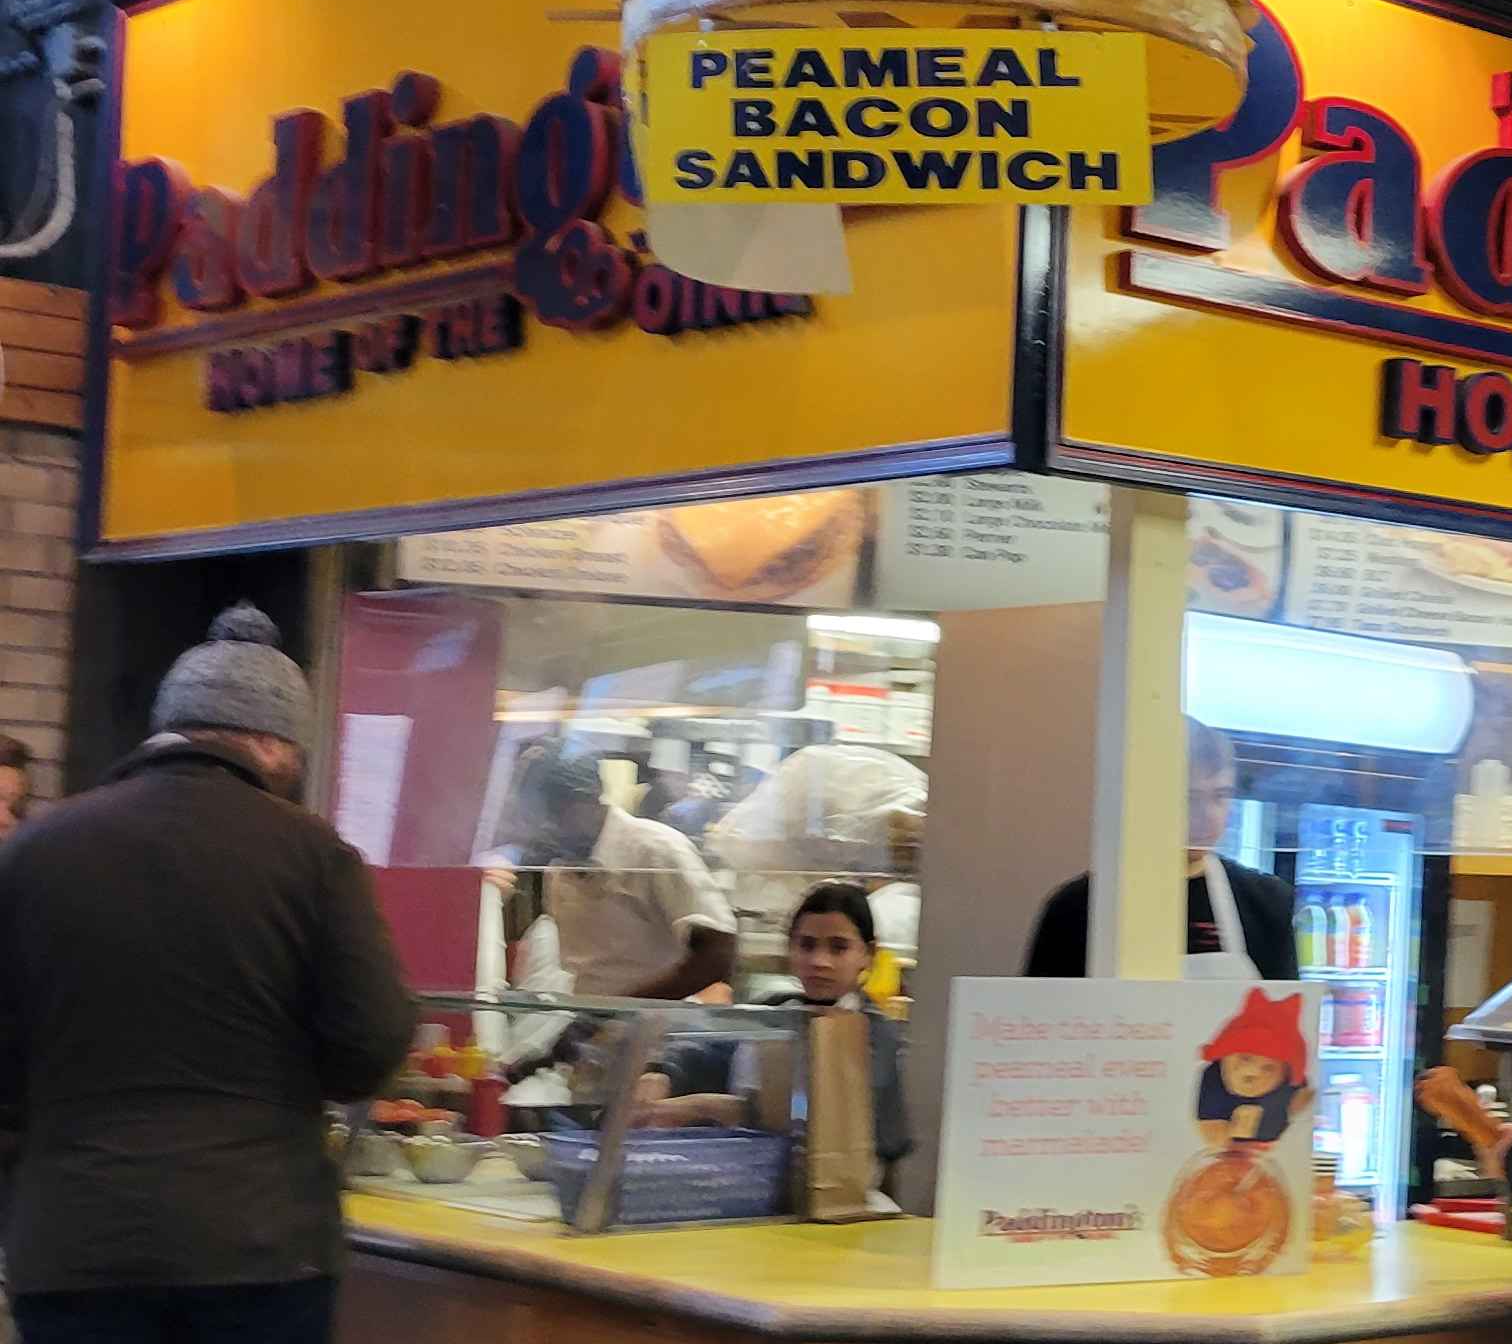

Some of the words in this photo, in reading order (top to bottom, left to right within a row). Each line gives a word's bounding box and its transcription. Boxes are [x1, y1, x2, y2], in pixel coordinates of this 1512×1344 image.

[689, 47, 1081, 89] PEAMEAL
[731, 97, 1031, 138] BACON
[673, 149, 1121, 191] SANDWICH
[207, 328, 354, 413] HOME
[354, 312, 423, 372] OF
[431, 292, 526, 359] THE
